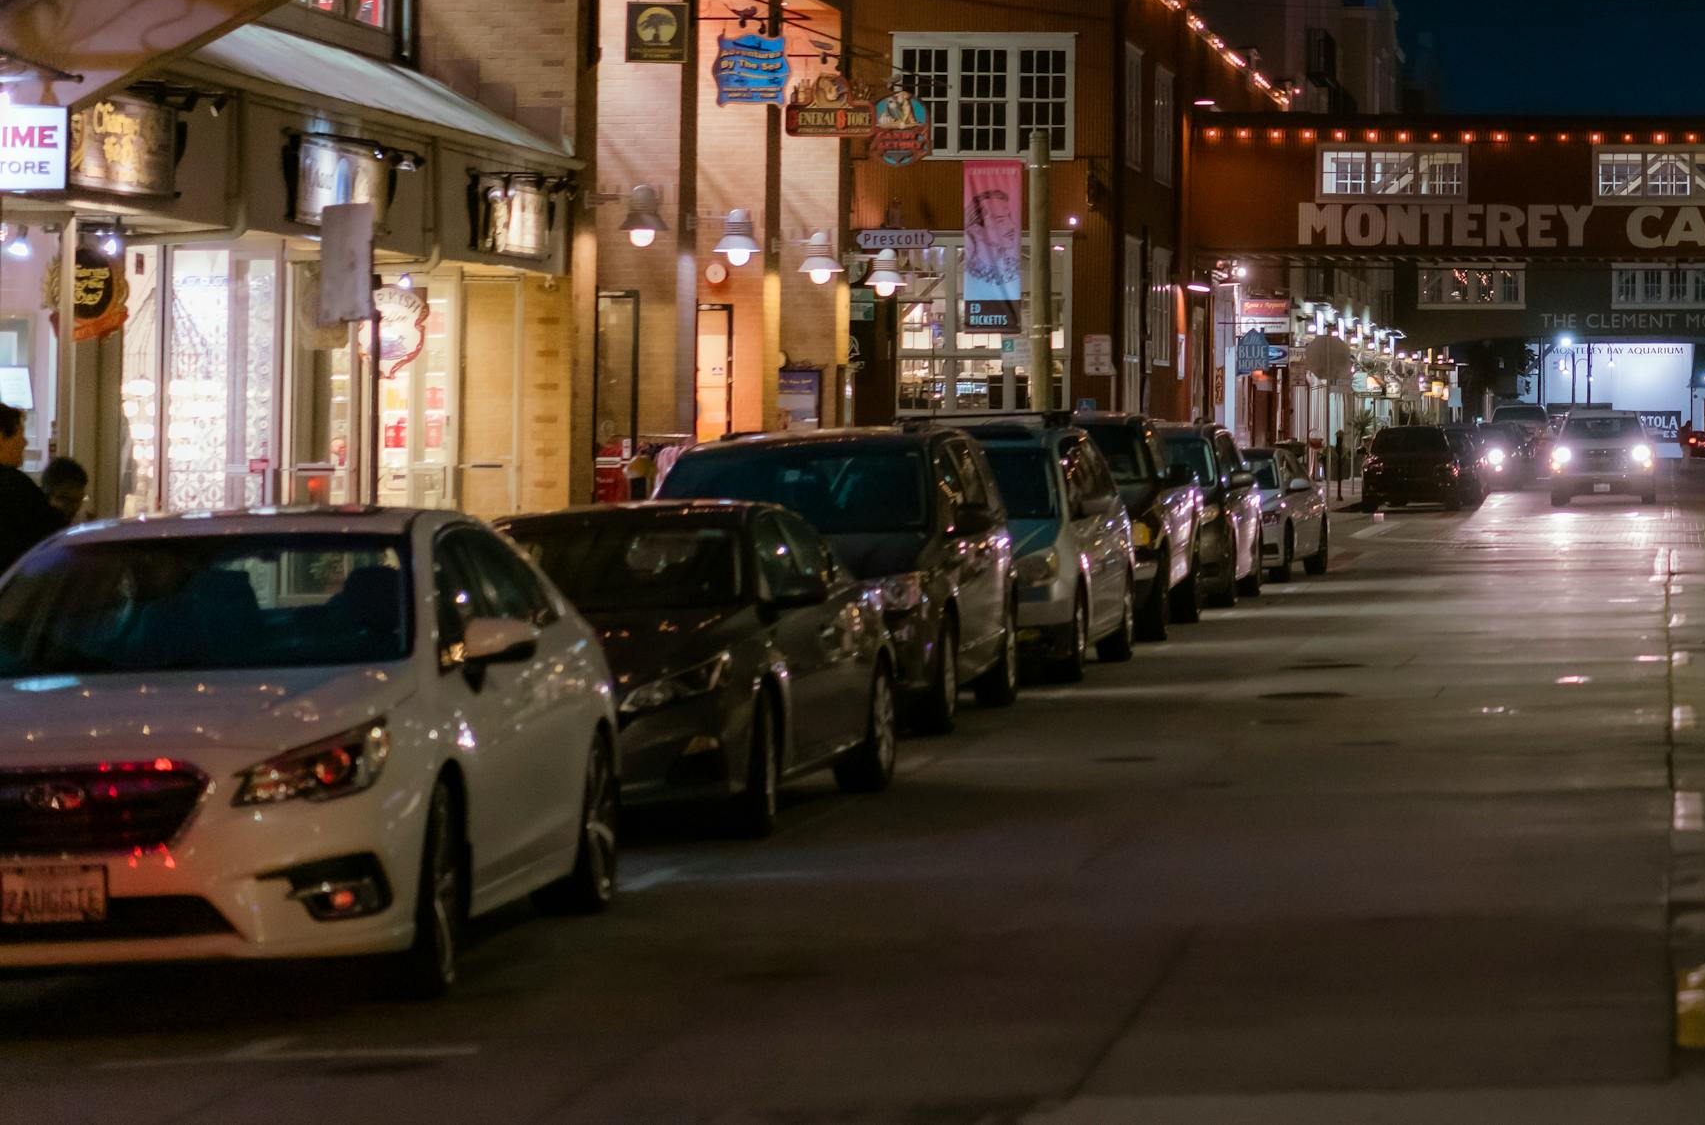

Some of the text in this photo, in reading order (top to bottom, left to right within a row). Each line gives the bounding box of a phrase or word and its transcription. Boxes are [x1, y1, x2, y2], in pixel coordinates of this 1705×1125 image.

[720, 58, 782, 71] By The Sea
[1, 125, 58, 149] IME
[1298, 202, 1594, 247] MONTEREY
[863, 232, 926, 246] Prescott
[969, 303, 982, 314] ED
[969, 314, 1008, 326] RICKETTS
[1540, 313, 1577, 329] THE
[1586, 313, 1677, 329] CLEMENT
[1238, 345, 1267, 358] BLUE
[1606, 346, 1625, 355] BAY
[1627, 346, 1684, 355] AQUARIUM
[1238, 359, 1267, 369] HOUSE
